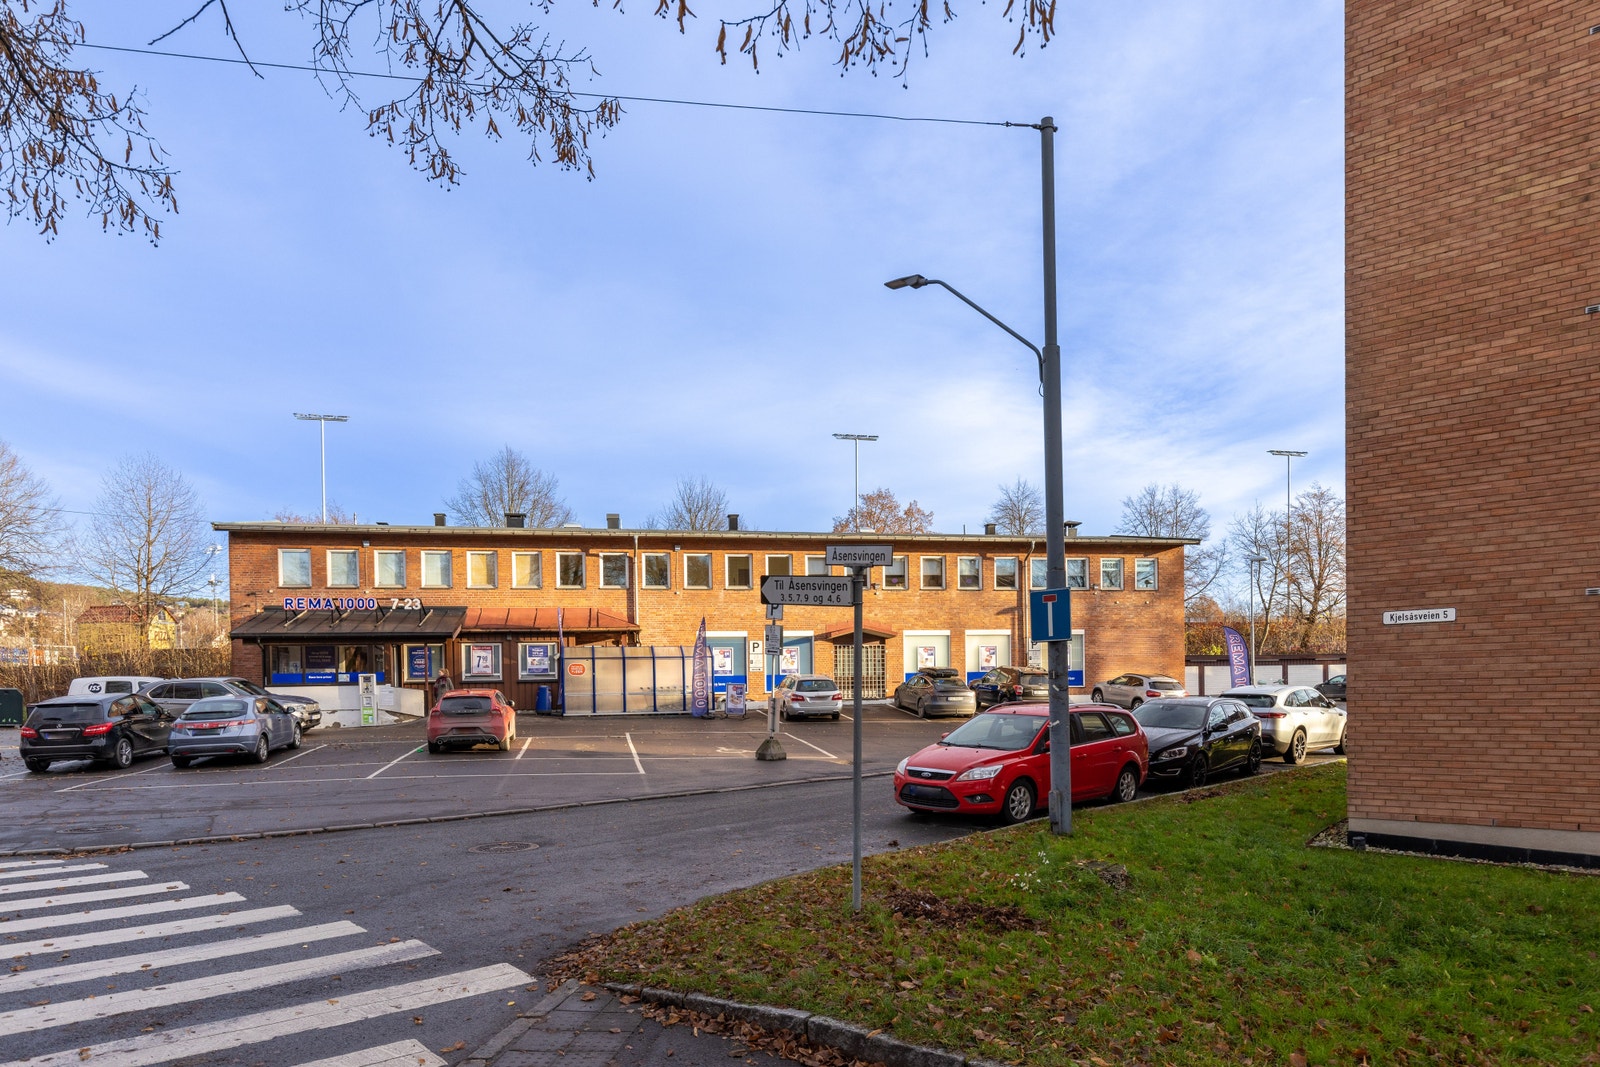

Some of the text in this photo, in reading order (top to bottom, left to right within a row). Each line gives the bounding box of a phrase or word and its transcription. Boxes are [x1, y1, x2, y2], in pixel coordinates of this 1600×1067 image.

[832, 547, 886, 563] Åsensvingen
[774, 577, 848, 593] Til Åsensvingen
[284, 598, 421, 610] REMA 1000 7-23
[813, 595, 824, 605] og
[770, 604, 780, 616] P
[1389, 610, 1448, 623] Kjelsåsveien 5
[752, 642, 760, 652] P
[1230, 634, 1246, 675] REMA
[476, 655, 482, 668] 7
[694, 672, 707, 708] 1000
